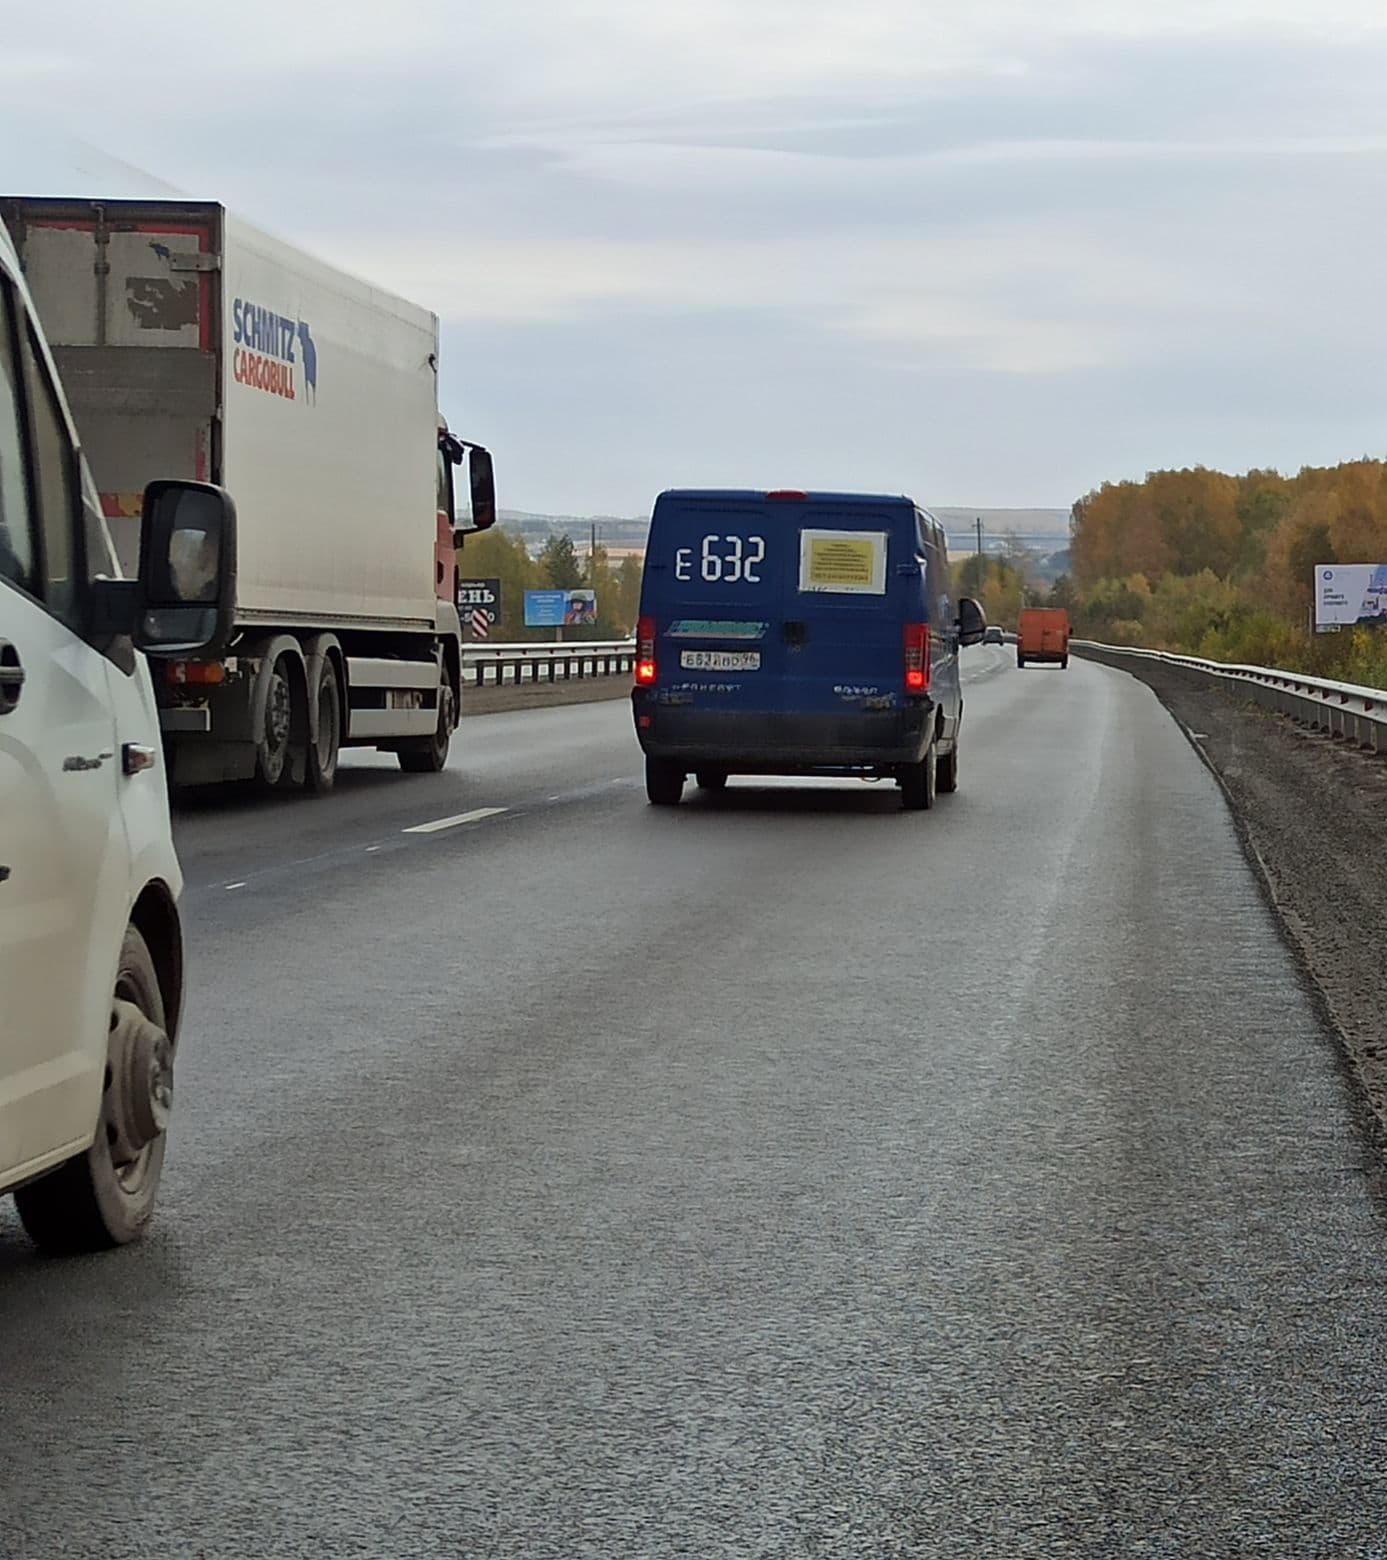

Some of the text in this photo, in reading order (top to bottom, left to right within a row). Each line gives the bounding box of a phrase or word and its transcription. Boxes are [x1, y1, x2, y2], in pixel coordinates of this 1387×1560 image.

[233, 298, 295, 364] SCHMITZ
[233, 347, 295, 401] CARGOBULL
[702, 535, 765, 582] 632
